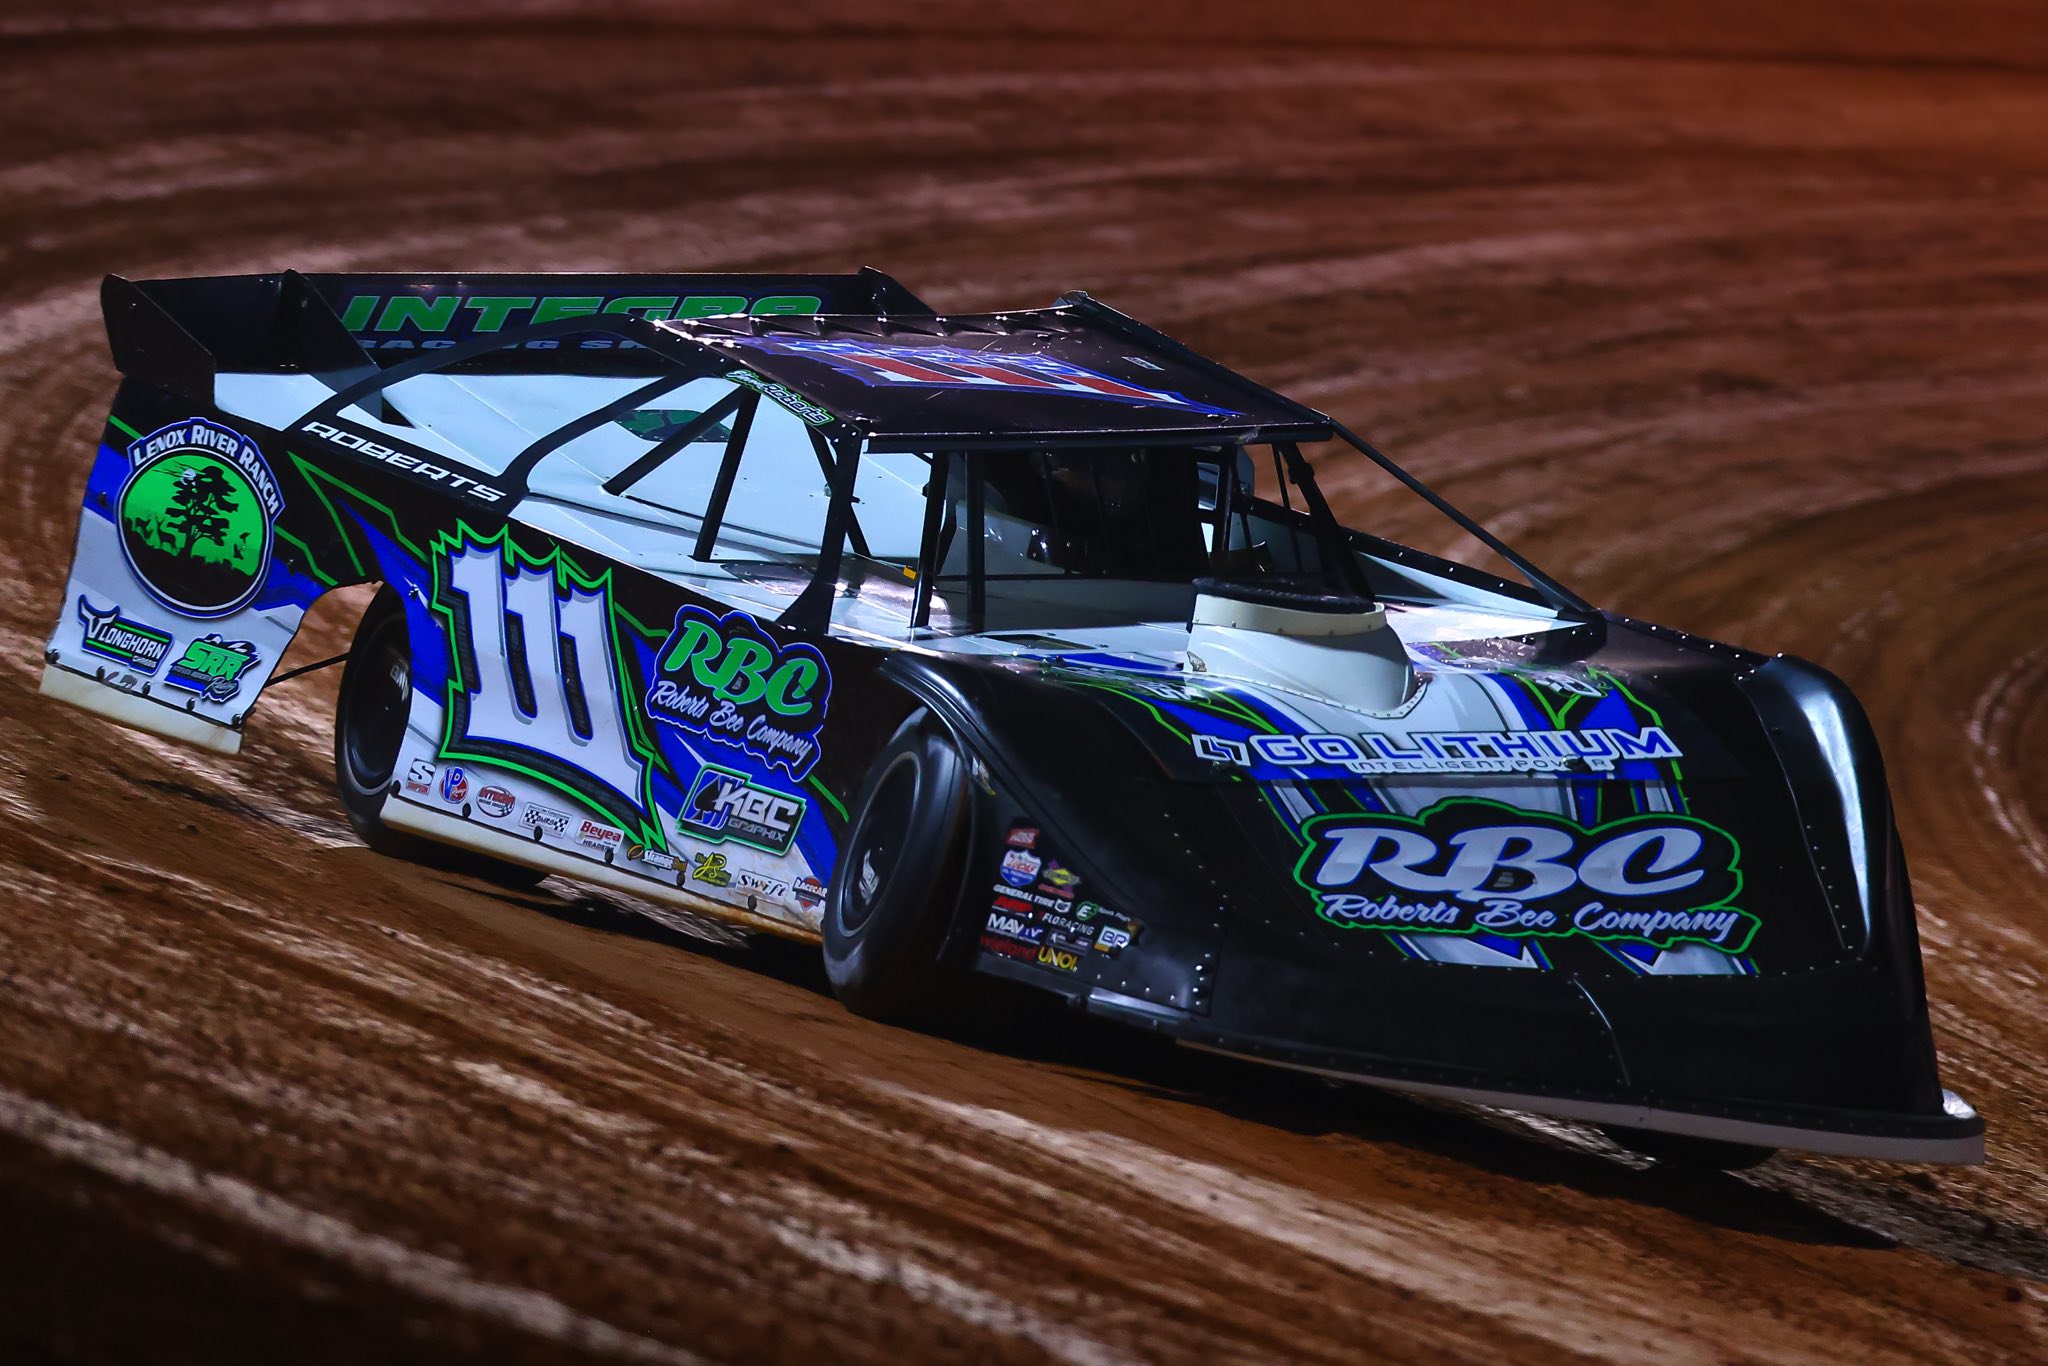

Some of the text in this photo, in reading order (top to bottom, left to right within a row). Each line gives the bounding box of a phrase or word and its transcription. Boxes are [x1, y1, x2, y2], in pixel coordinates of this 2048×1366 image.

[134, 425, 280, 514] LENOX RIVER RANCH
[301, 421, 507, 502] ROBERTS
[101, 627, 167, 660] LONGHORN
[178, 641, 250, 681] SRR
[664, 620, 819, 716] RBC
[651, 681, 813, 767] Roberts Bee Company
[712, 782, 799, 831] KBC
[728, 818, 786, 843] GRAPHIX
[580, 821, 622, 843] Beyea
[738, 875, 788, 897] Swift
[1316, 826, 1705, 900] RBC
[1322, 894, 1739, 942] Roberts Bee Company
